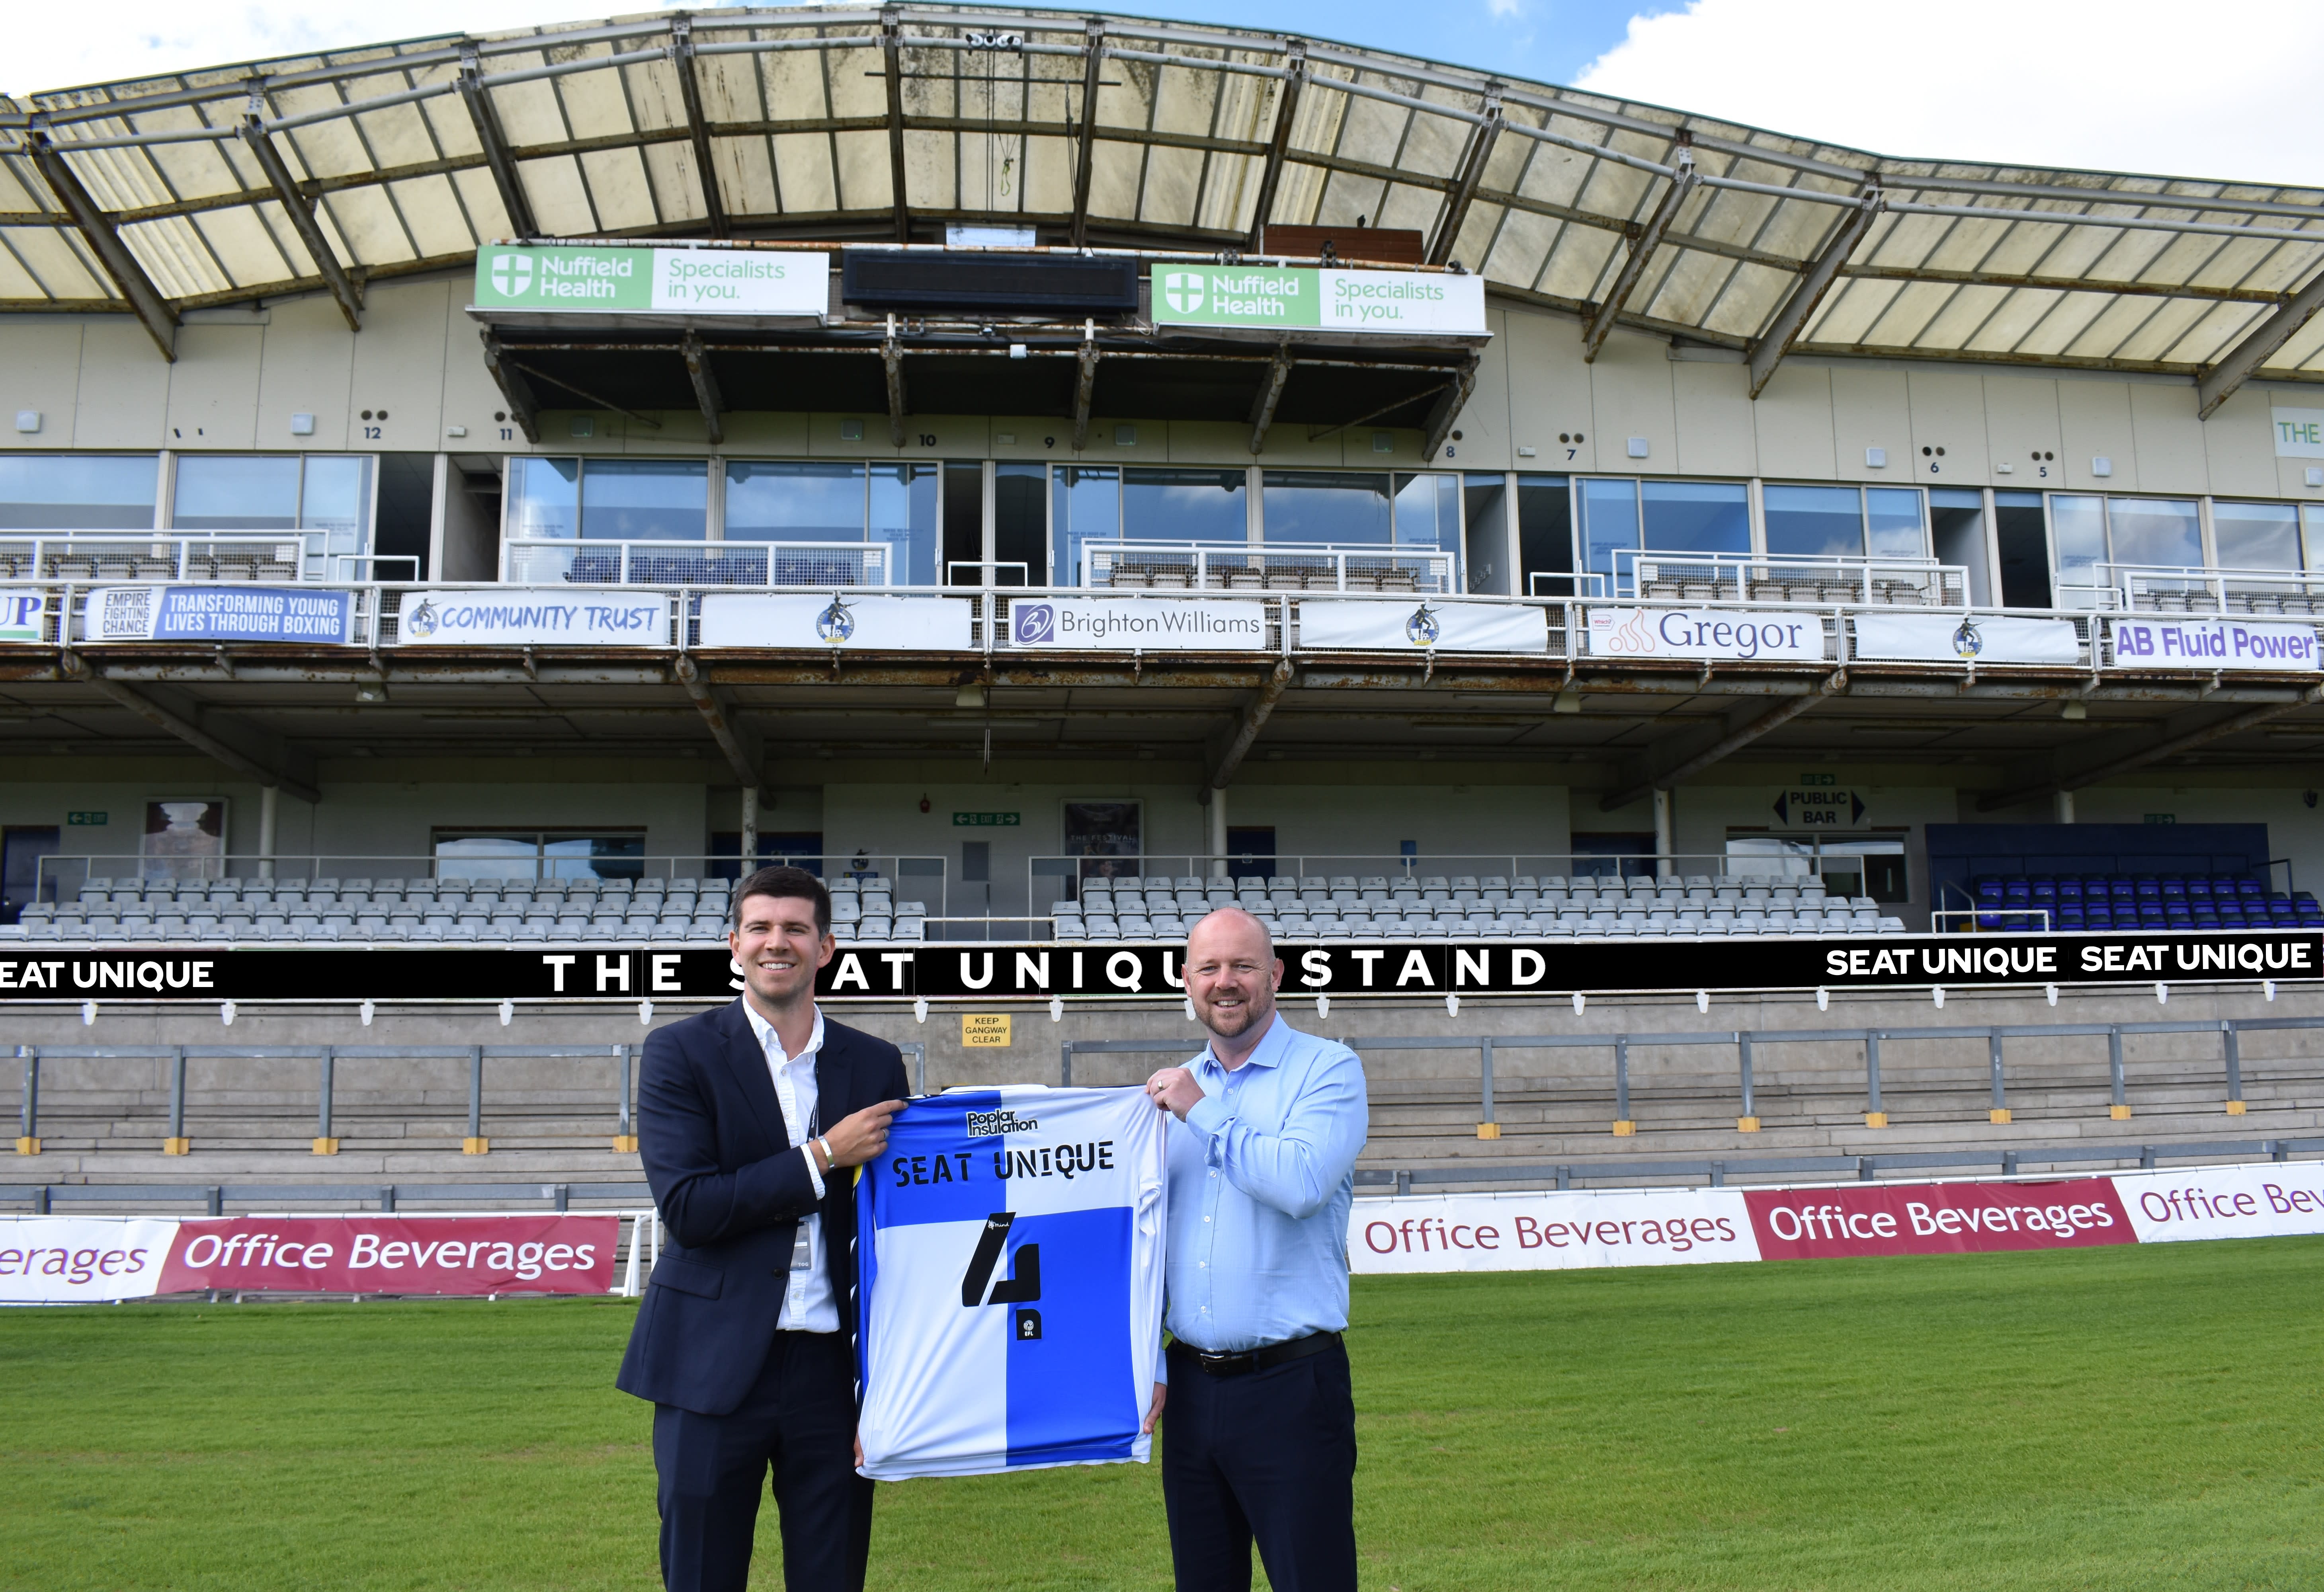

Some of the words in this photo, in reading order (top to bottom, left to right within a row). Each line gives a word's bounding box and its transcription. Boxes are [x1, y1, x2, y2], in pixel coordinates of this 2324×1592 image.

[541, 256, 632, 278] Nuffield
[669, 259, 786, 281] Specialists
[541, 276, 616, 298] Health
[669, 281, 686, 297] in
[694, 283, 740, 302] you.
[1213, 275, 1299, 296] Nuffield
[1335, 279, 1444, 304] Specialists
[1213, 295, 1285, 316] Health
[1335, 299, 1353, 319] in
[1359, 303, 1404, 322] you.
[364, 427, 381, 439] 12
[500, 428, 512, 441] 11
[919, 434, 936, 446] 10
[1045, 437, 1054, 448] 9
[2277, 422, 2320, 444] THE
[1446, 446, 1455, 458] 8
[1567, 449, 1576, 460] 7
[1930, 462, 1939, 473] 6
[2039, 466, 2047, 478] 5
[106, 593, 150, 606] EMPIRE
[170, 595, 283, 613] TRANSFORMING
[289, 598, 338, 616] YOUNG
[104, 608, 150, 619] FIGHTING
[441, 606, 578, 630] COMMUNITY
[585, 607, 659, 630] TRUST
[1062, 610, 1158, 638] Brighton
[1162, 611, 1259, 633] Williams
[103, 620, 148, 633] CHANCE
[165, 614, 204, 630] LIVES
[209, 615, 278, 633] THROUGH
[283, 617, 339, 635] BOXING
[1660, 613, 1803, 658] Gregor
[2117, 626, 2154, 655] AB
[2162, 627, 2226, 656] Fluid
[2232, 628, 2313, 659] Power
[1790, 792, 1847, 804] PUBLIC
[1803, 811, 1836, 823] BAR
[1826, 949, 1914, 975] SEAT
[1922, 947, 2057, 977] UNIQUE
[2080, 945, 2170, 972] SEAT
[2177, 943, 2311, 973] UNIQUE
[73, 961, 214, 991] UNIQUE
[543, 955, 681, 991] THE
[960, 950, 1185, 993] UNIQU
[1300, 949, 1545, 986] STAND
[968, 1110, 1015, 1126] Poplar
[969, 1120, 1037, 1135] Insulation
[893, 1153, 971, 1187] SEAT
[994, 1141, 1114, 1180] UNIQUE
[2139, 1186, 2257, 1223] Office
[1769, 1204, 1897, 1242] Office
[1906, 1202, 2113, 1238] Beverages
[1365, 1217, 1500, 1253] Office
[1514, 1215, 1736, 1252] Beverages
[184, 1233, 333, 1269] Office
[348, 1234, 596, 1280] Beverages
[962, 1212, 1041, 1307] 4
